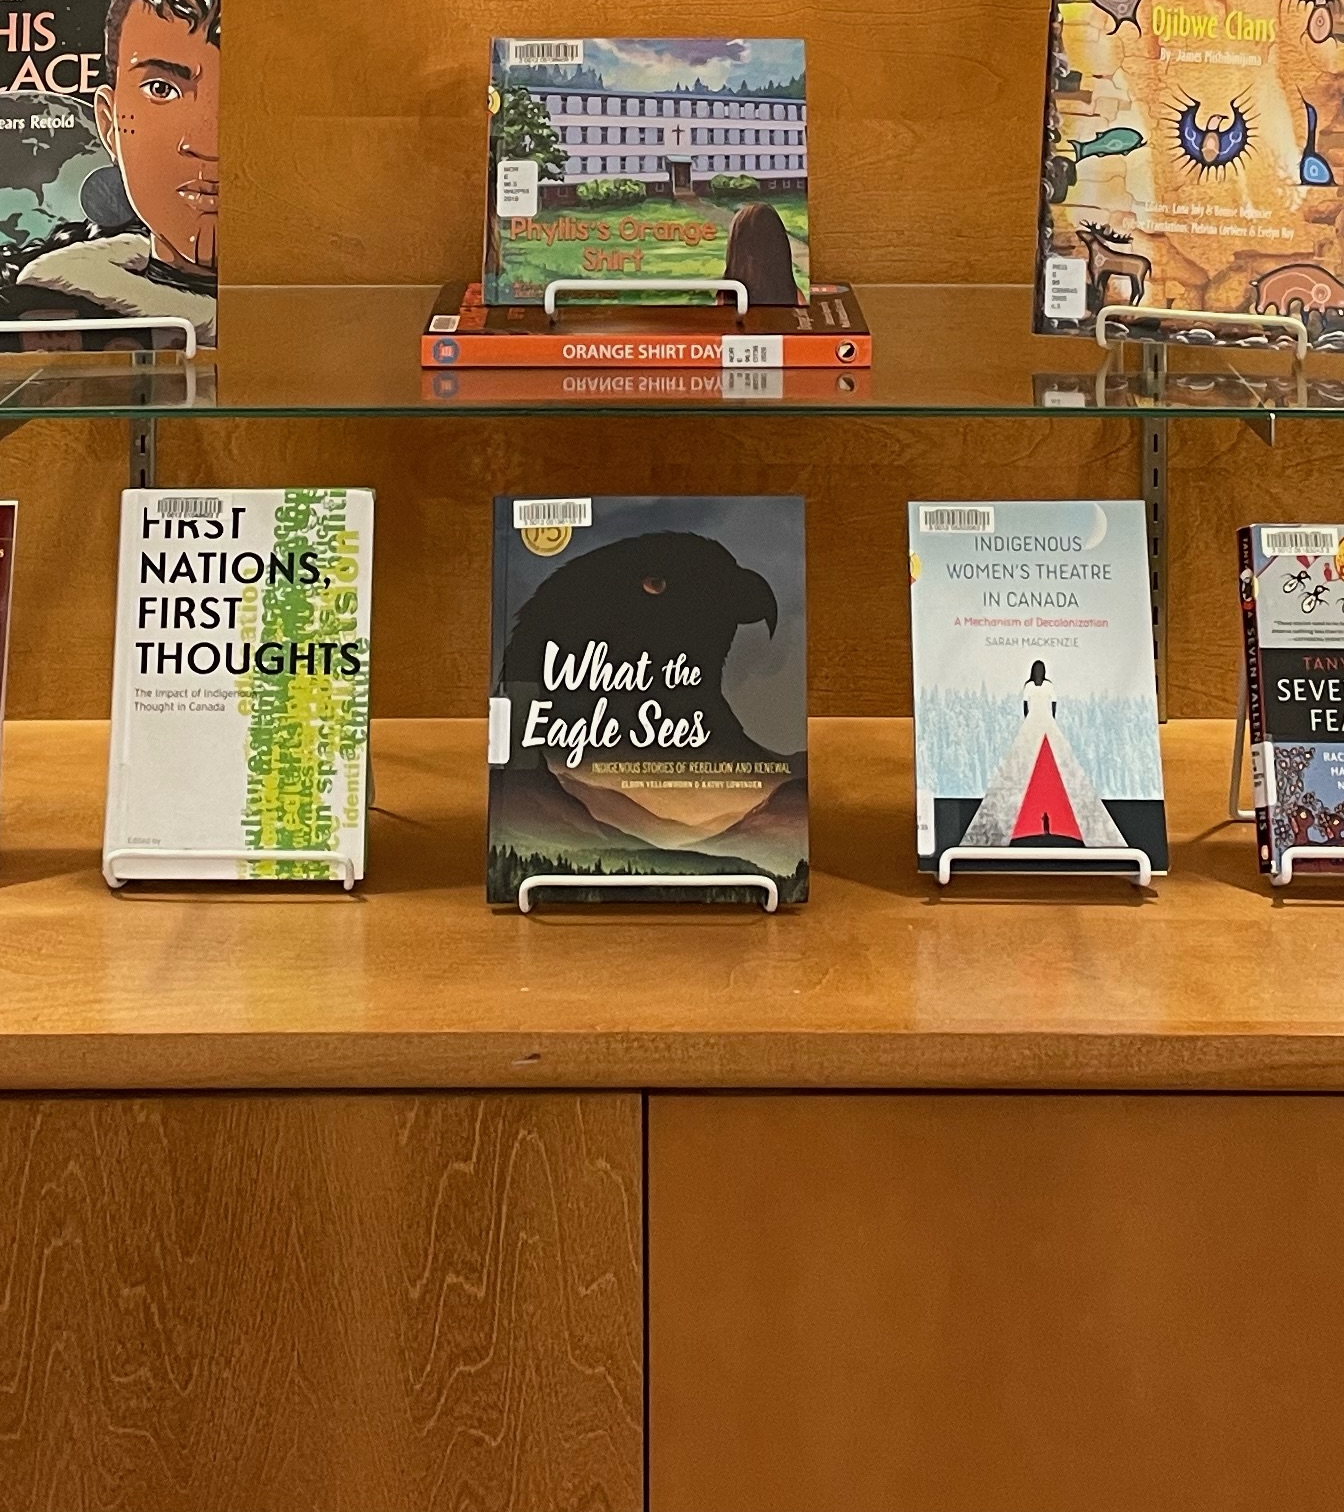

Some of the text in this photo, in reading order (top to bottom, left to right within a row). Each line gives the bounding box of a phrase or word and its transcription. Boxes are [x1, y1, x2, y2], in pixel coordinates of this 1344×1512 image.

[1152, 5, 1276, 43] Ojibwe Clans
[30, 114, 75, 129] Retold
[509, 216, 717, 245] Phyllis's Orange
[582, 247, 645, 271] Shirt
[563, 344, 634, 359] ORANGE
[638, 344, 687, 359] SHIRT
[691, 344, 723, 359] DAY
[142, 506, 247, 540] FIRST
[974, 536, 1082, 552] INDIGENOUS
[140, 551, 332, 590] NATIONS,
[946, 563, 1112, 580] WOMEN'S THEATRE
[983, 592, 1079, 608] IN CANADA
[138, 596, 243, 630] FIRST
[954, 616, 1108, 628] A Mechanism of Decolonization
[985, 637, 1079, 648] SARAH MACKENZIE
[135, 641, 362, 676] THOUGHTS
[543, 640, 702, 692] What the
[522, 697, 711, 768] Eagle Sees
[591, 762, 791, 774] INDIGENOUS STORIES OF REBELLION AND RENEWAL
